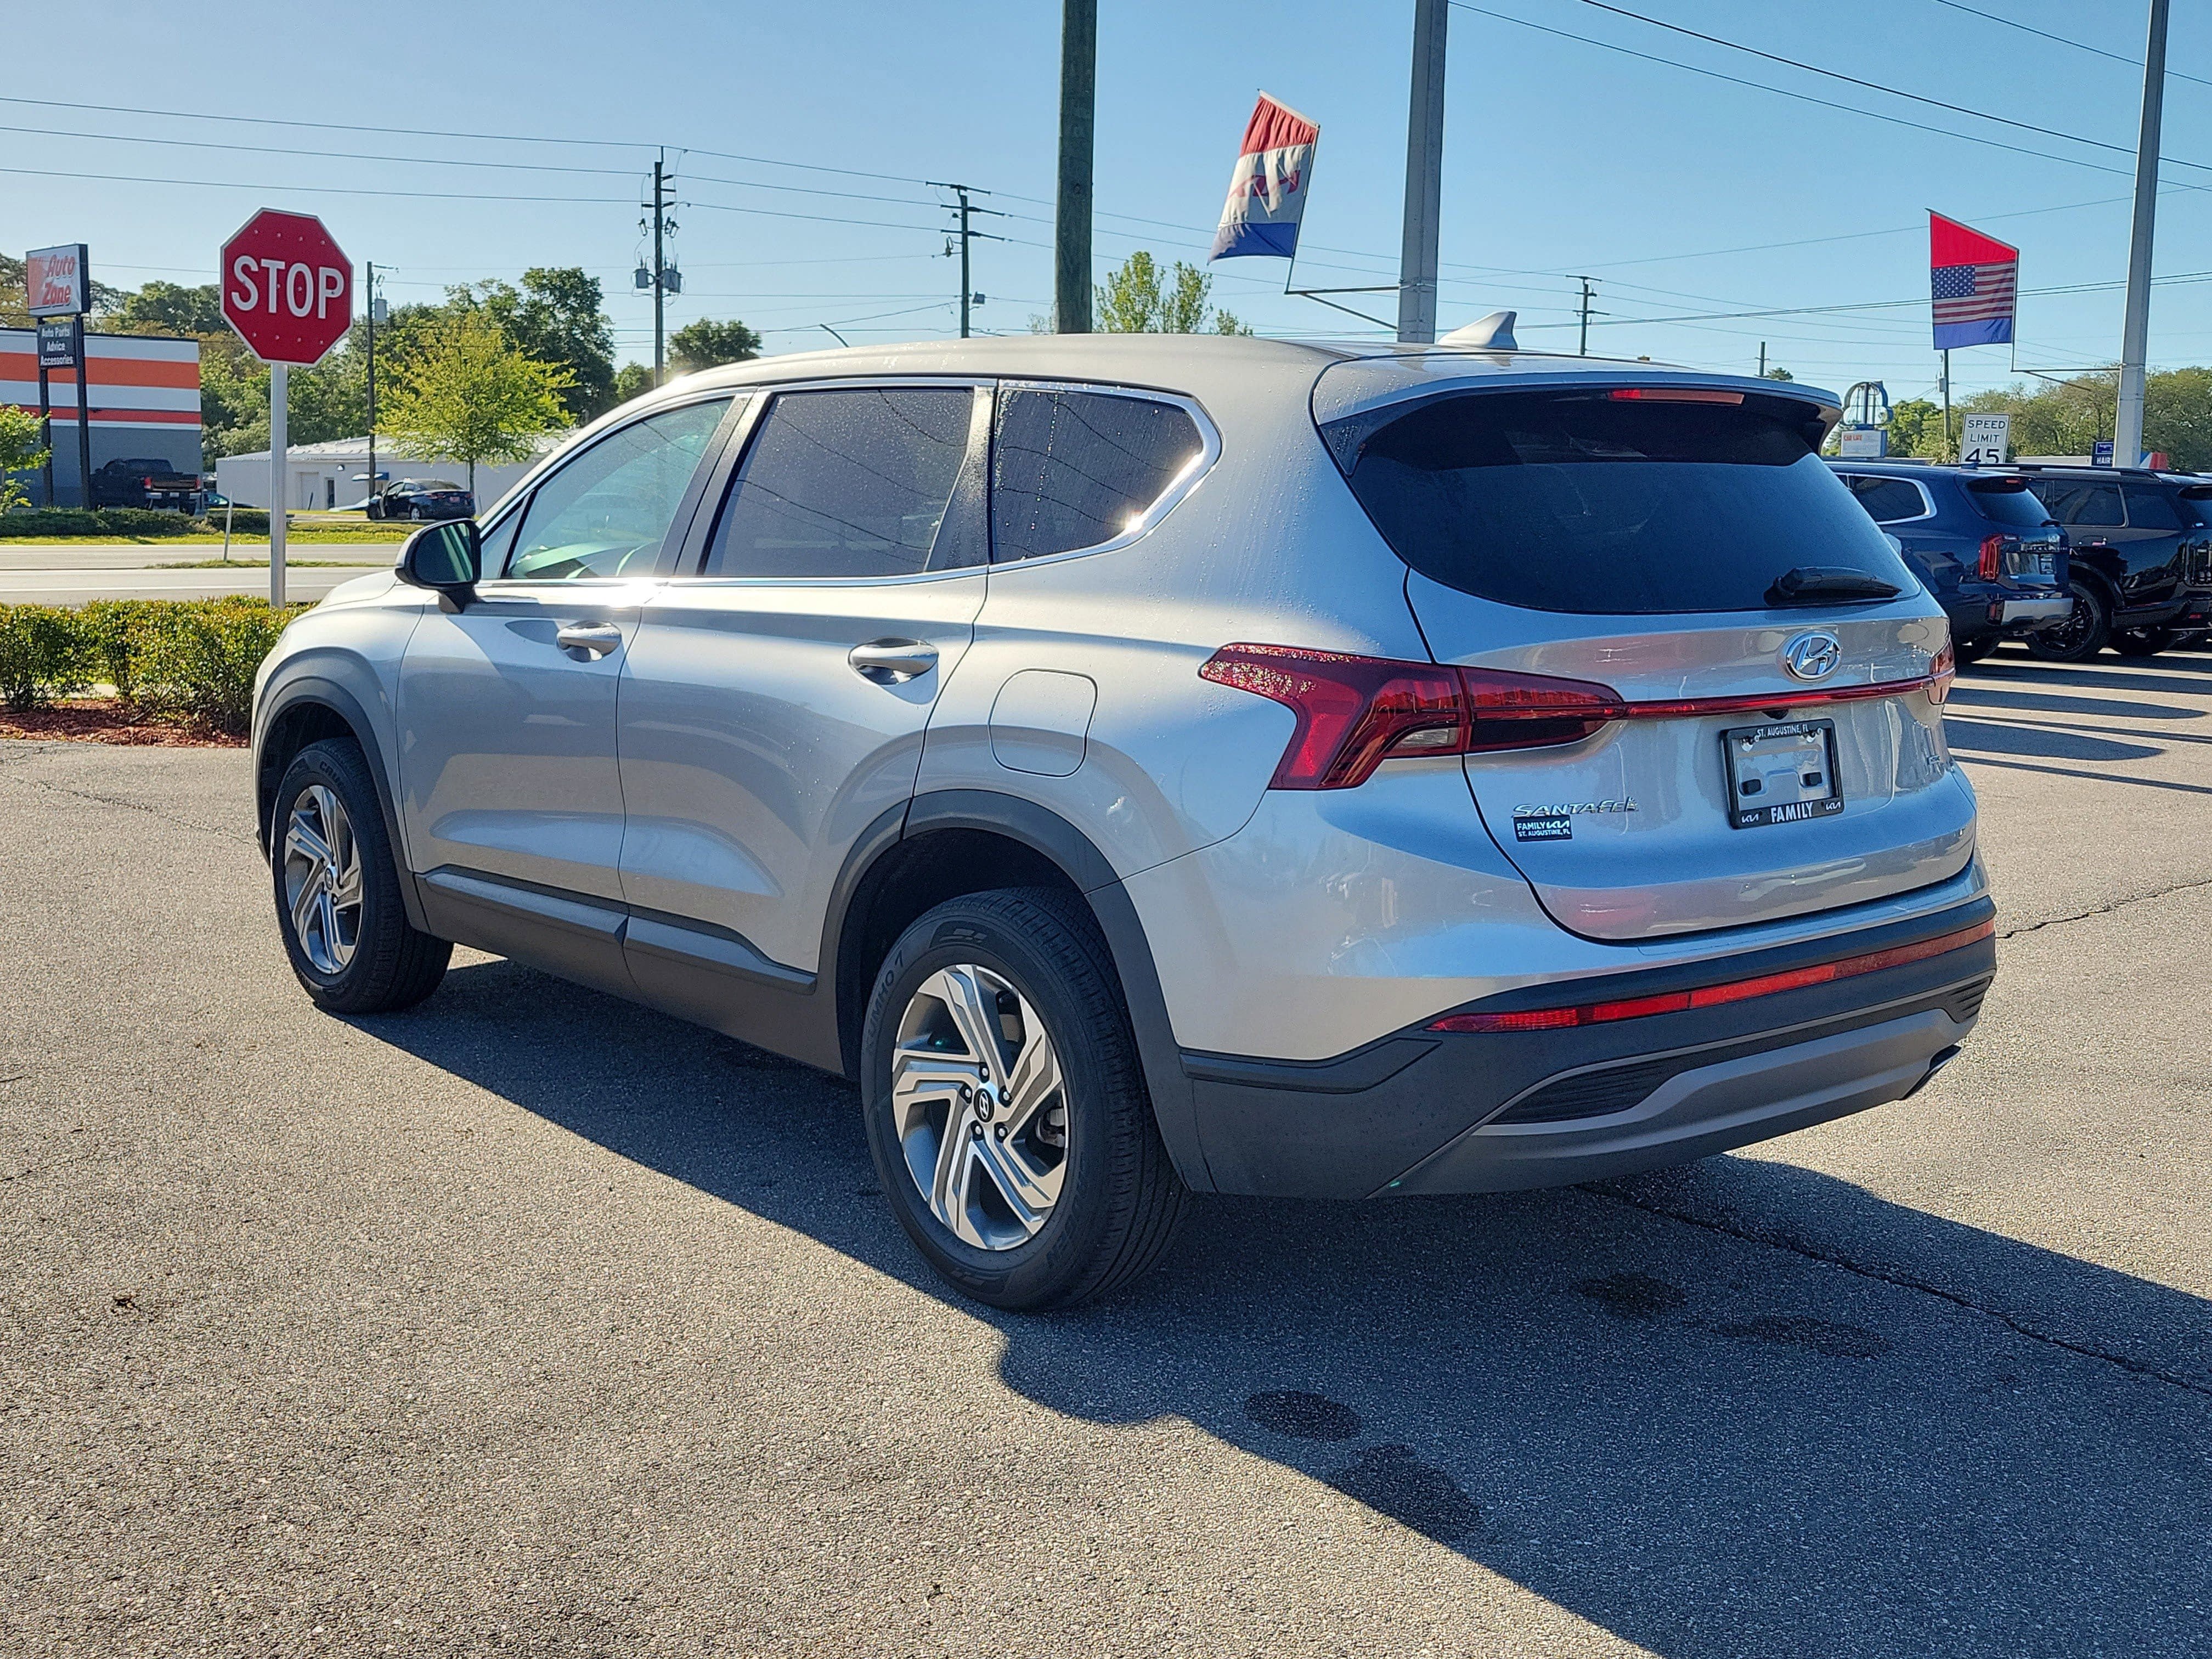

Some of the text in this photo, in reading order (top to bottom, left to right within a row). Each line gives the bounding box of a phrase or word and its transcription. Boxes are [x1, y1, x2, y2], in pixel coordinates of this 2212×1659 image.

[46, 254, 76, 278] Auto
[42, 281, 72, 306] Zone
[230, 256, 345, 319] STOP
[55, 326, 70, 337] Parts
[46, 341, 65, 352] Advice
[40, 354, 74, 366] Accessories
[1967, 420, 2006, 428] SPEED
[1970, 433, 2000, 443] LIMIT
[1965, 448, 2000, 463] 45
[1757, 728, 1765, 738] ST.
[1802, 724, 1809, 733] FL
[1770, 802, 1813, 823] FAMILY
[1516, 821, 1545, 831] FAMILY
